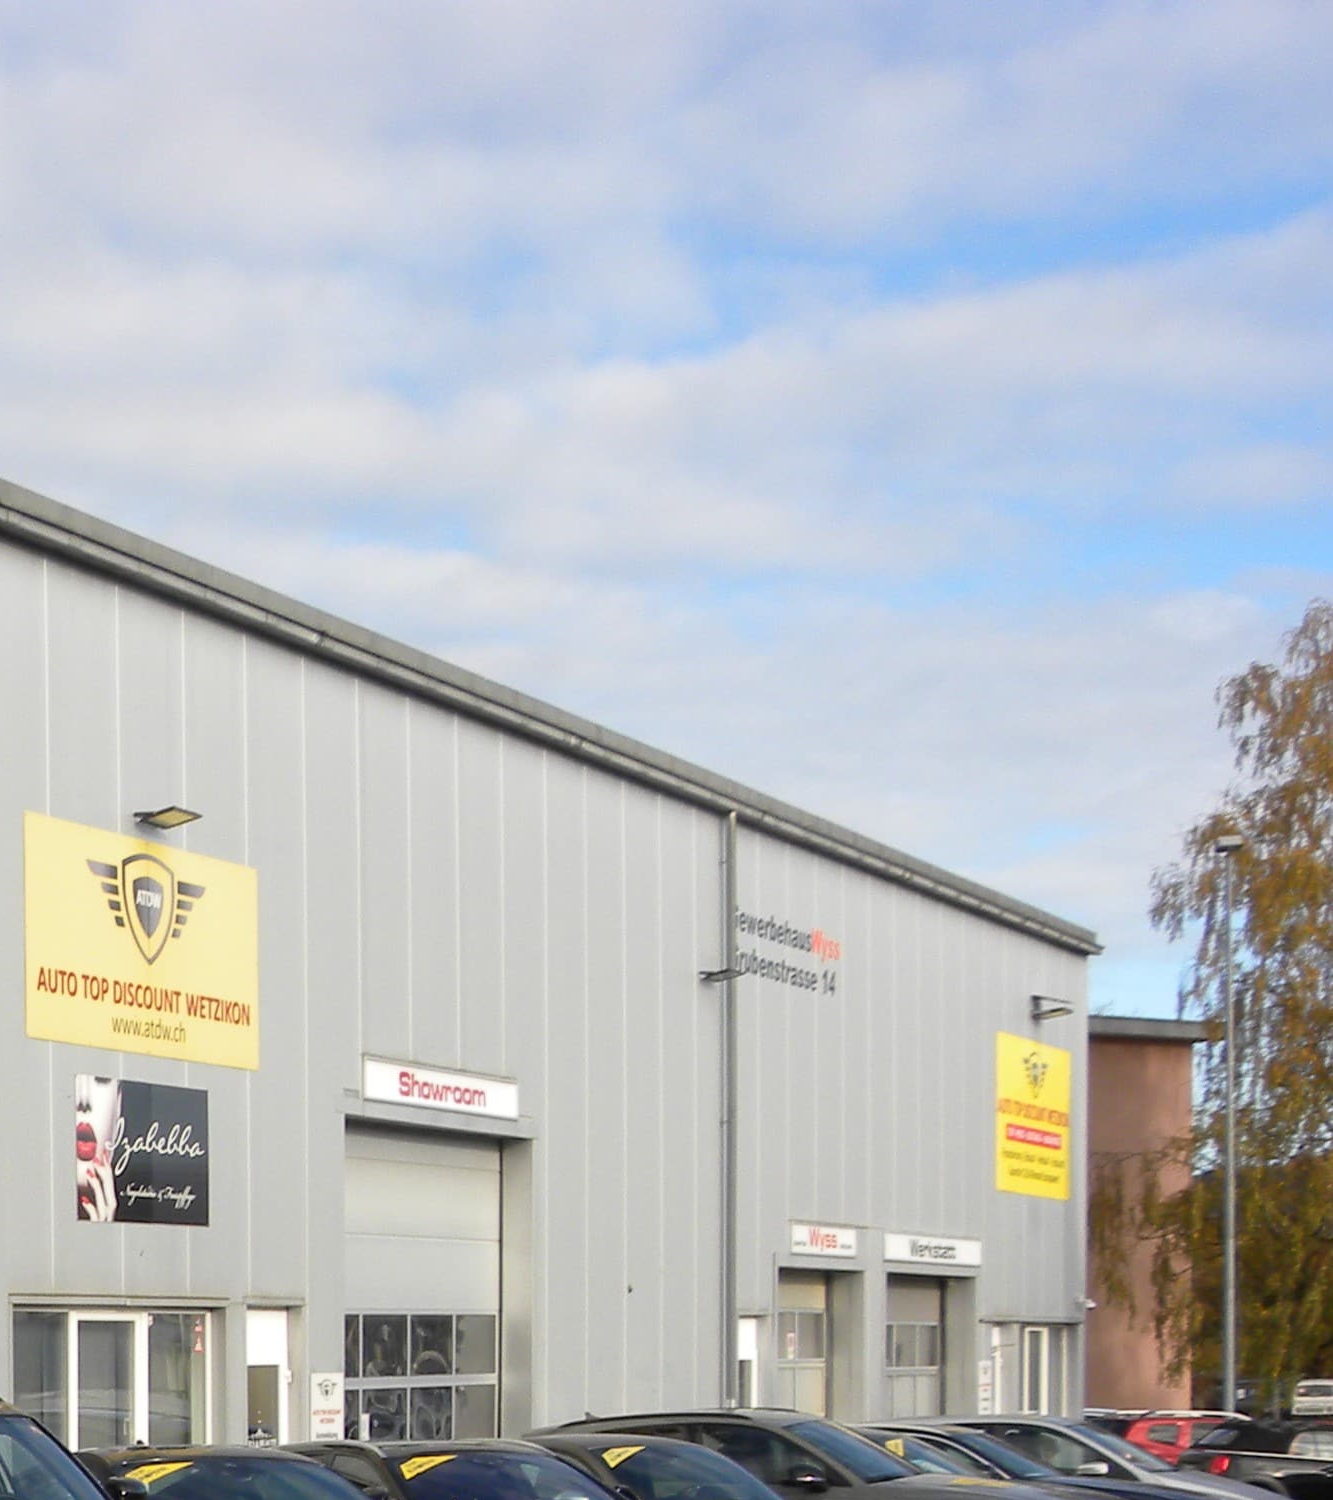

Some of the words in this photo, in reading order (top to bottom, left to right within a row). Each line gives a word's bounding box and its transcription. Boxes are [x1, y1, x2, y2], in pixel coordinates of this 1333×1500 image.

[136, 889, 162, 910] ATDW
[36, 966, 78, 997] AUTO
[81, 974, 109, 1002] TOP
[113, 980, 181, 1014] DISCOUNT
[185, 992, 251, 1027] WETZIKON
[111, 1016, 187, 1043] www.atdw.ch
[398, 1070, 487, 1108] Showroom
[808, 1223, 838, 1252] Wyss
